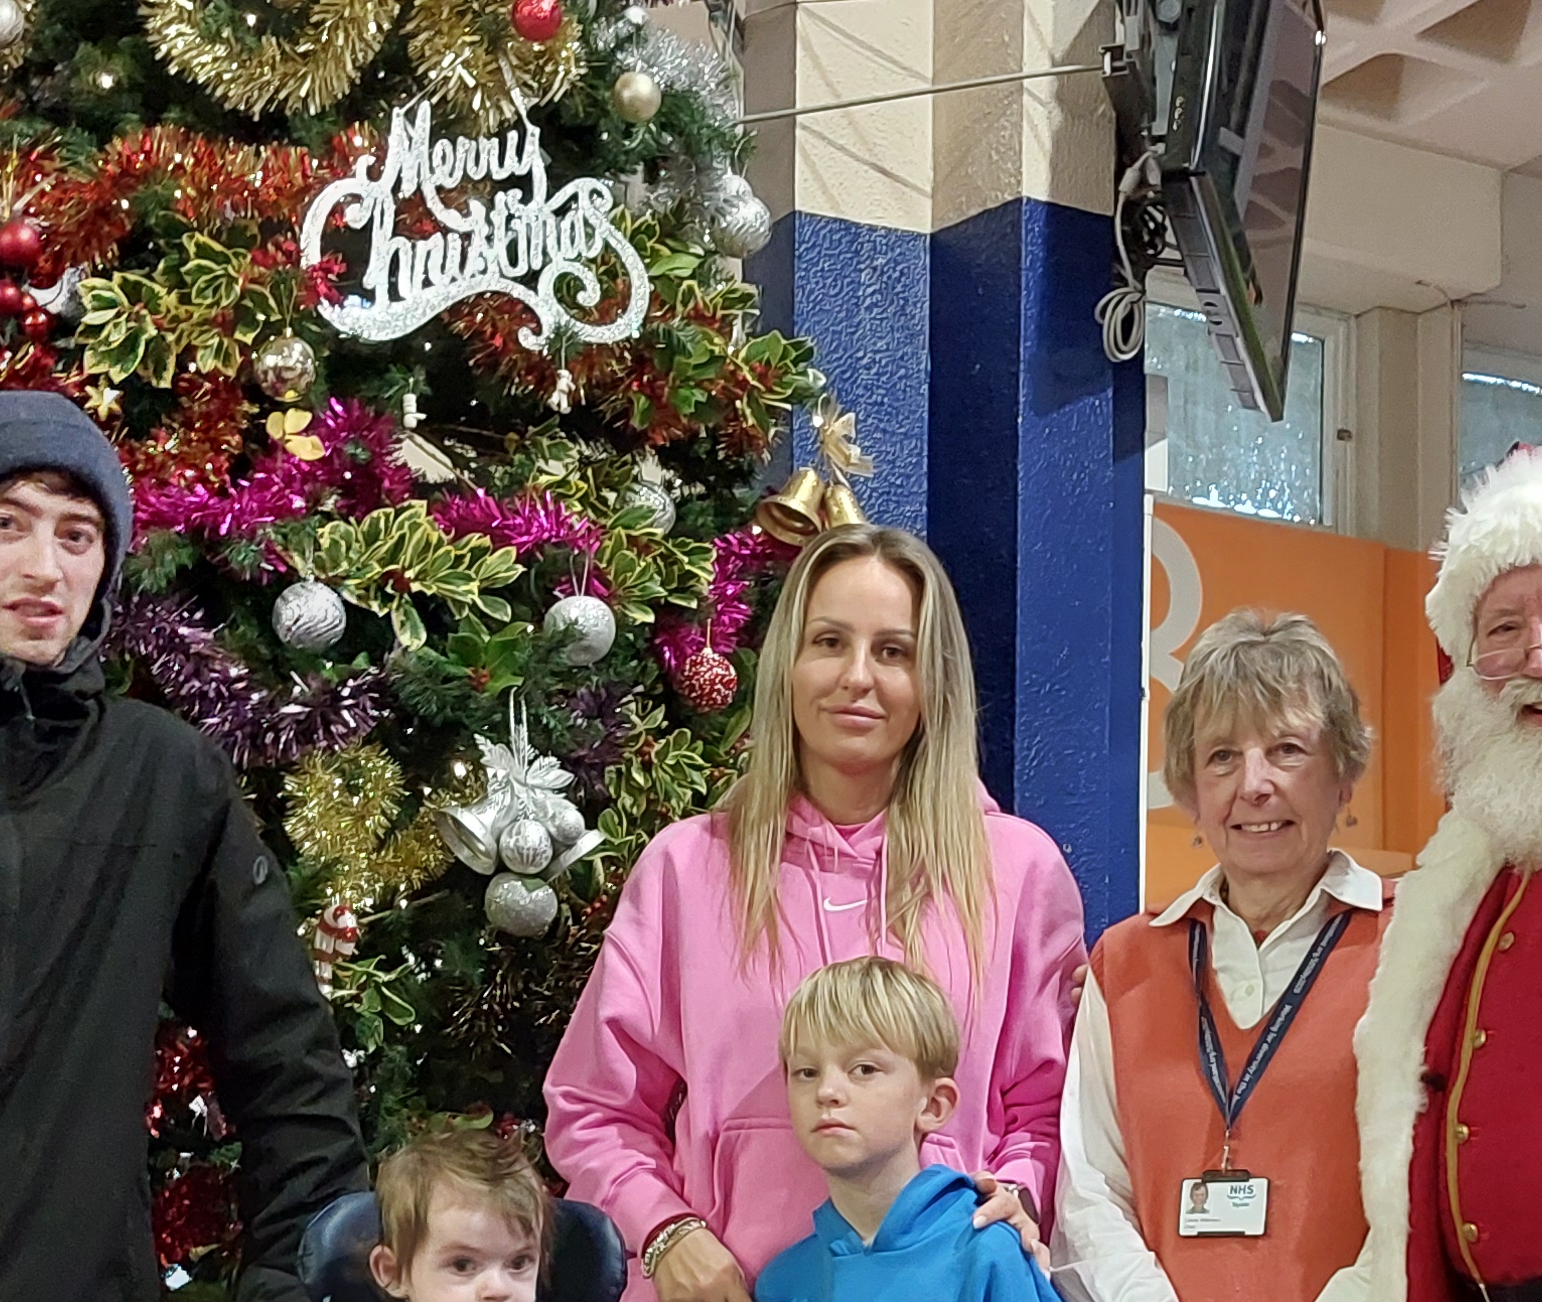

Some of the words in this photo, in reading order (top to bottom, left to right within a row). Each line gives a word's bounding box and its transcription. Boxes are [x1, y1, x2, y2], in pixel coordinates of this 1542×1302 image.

[356, 100, 548, 203] Merry
[300, 177, 650, 350] Christmas
[1229, 1185, 1255, 1195] NHS
